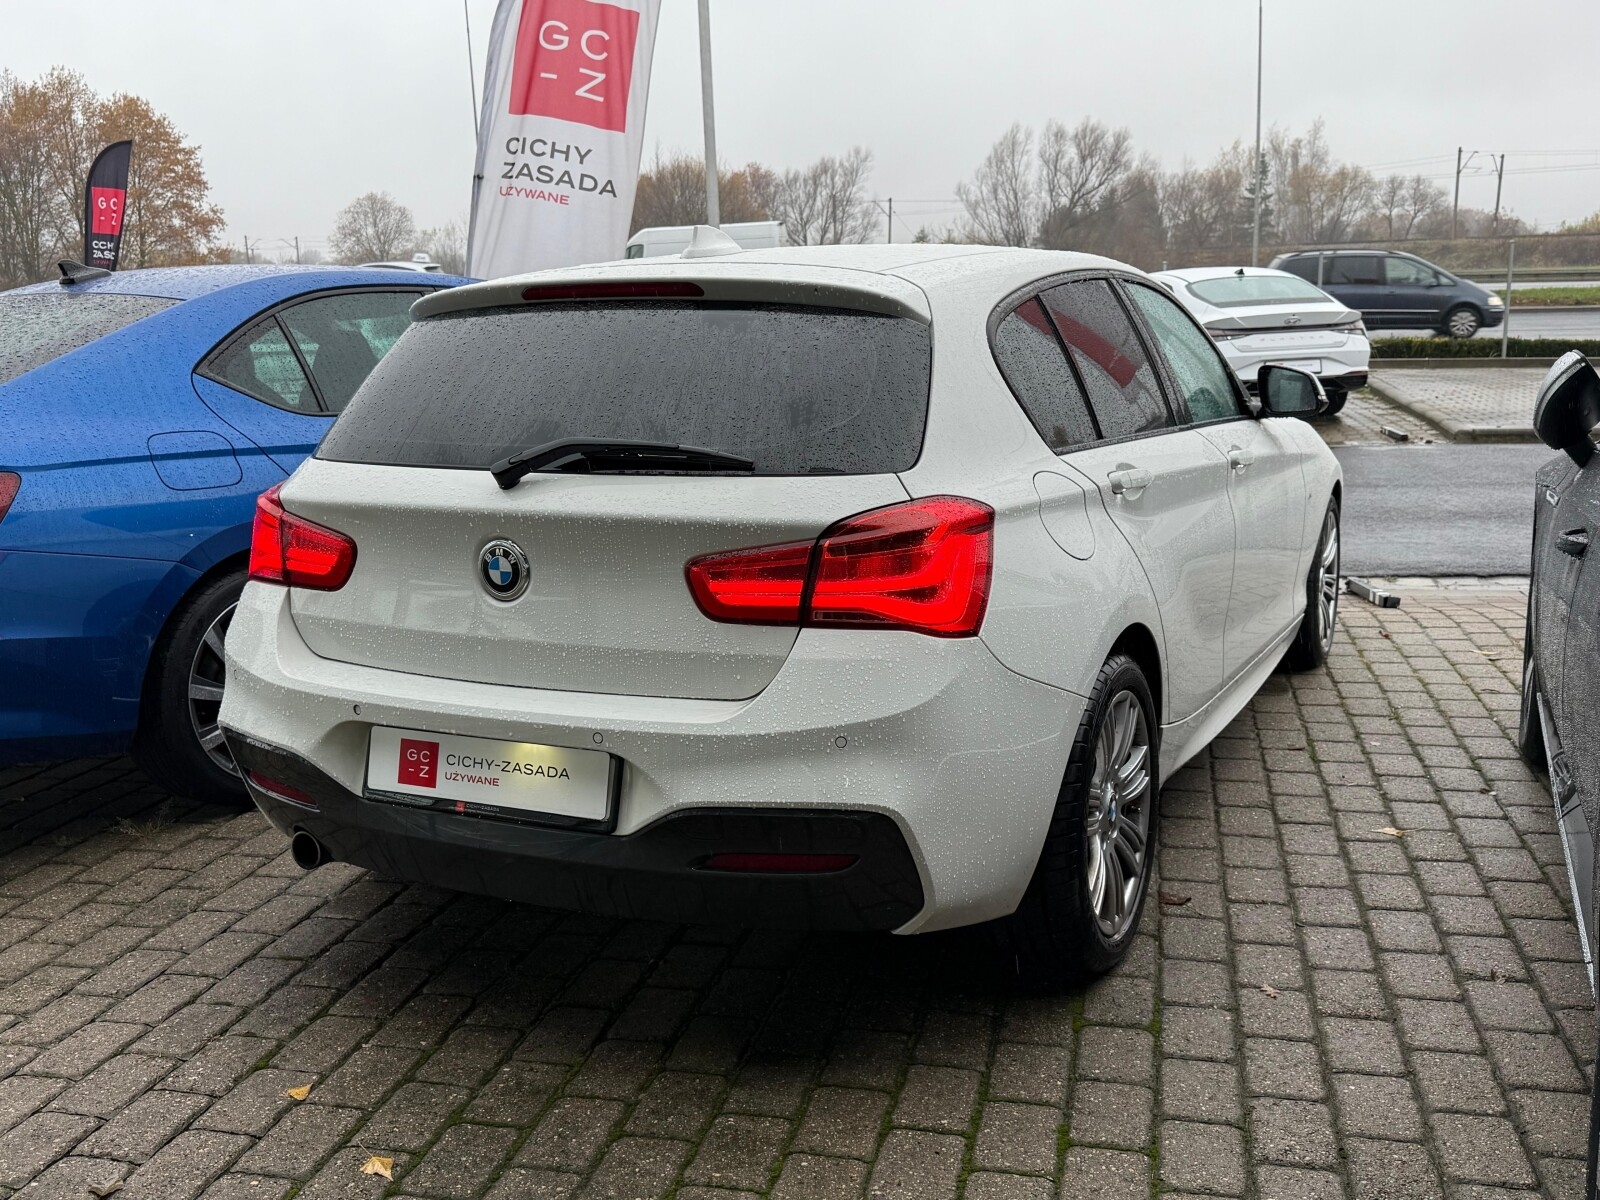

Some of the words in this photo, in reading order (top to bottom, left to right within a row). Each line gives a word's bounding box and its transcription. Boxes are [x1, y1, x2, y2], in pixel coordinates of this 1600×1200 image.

[505, 136, 593, 165] CICHY
[501, 161, 618, 198] ZASADA
[499, 183, 570, 206] UŻYWANE
[483, 548, 517, 565] BMW
[444, 771, 500, 787] UŻYWANE
[446, 753, 571, 781] CICHY-ZASADA
